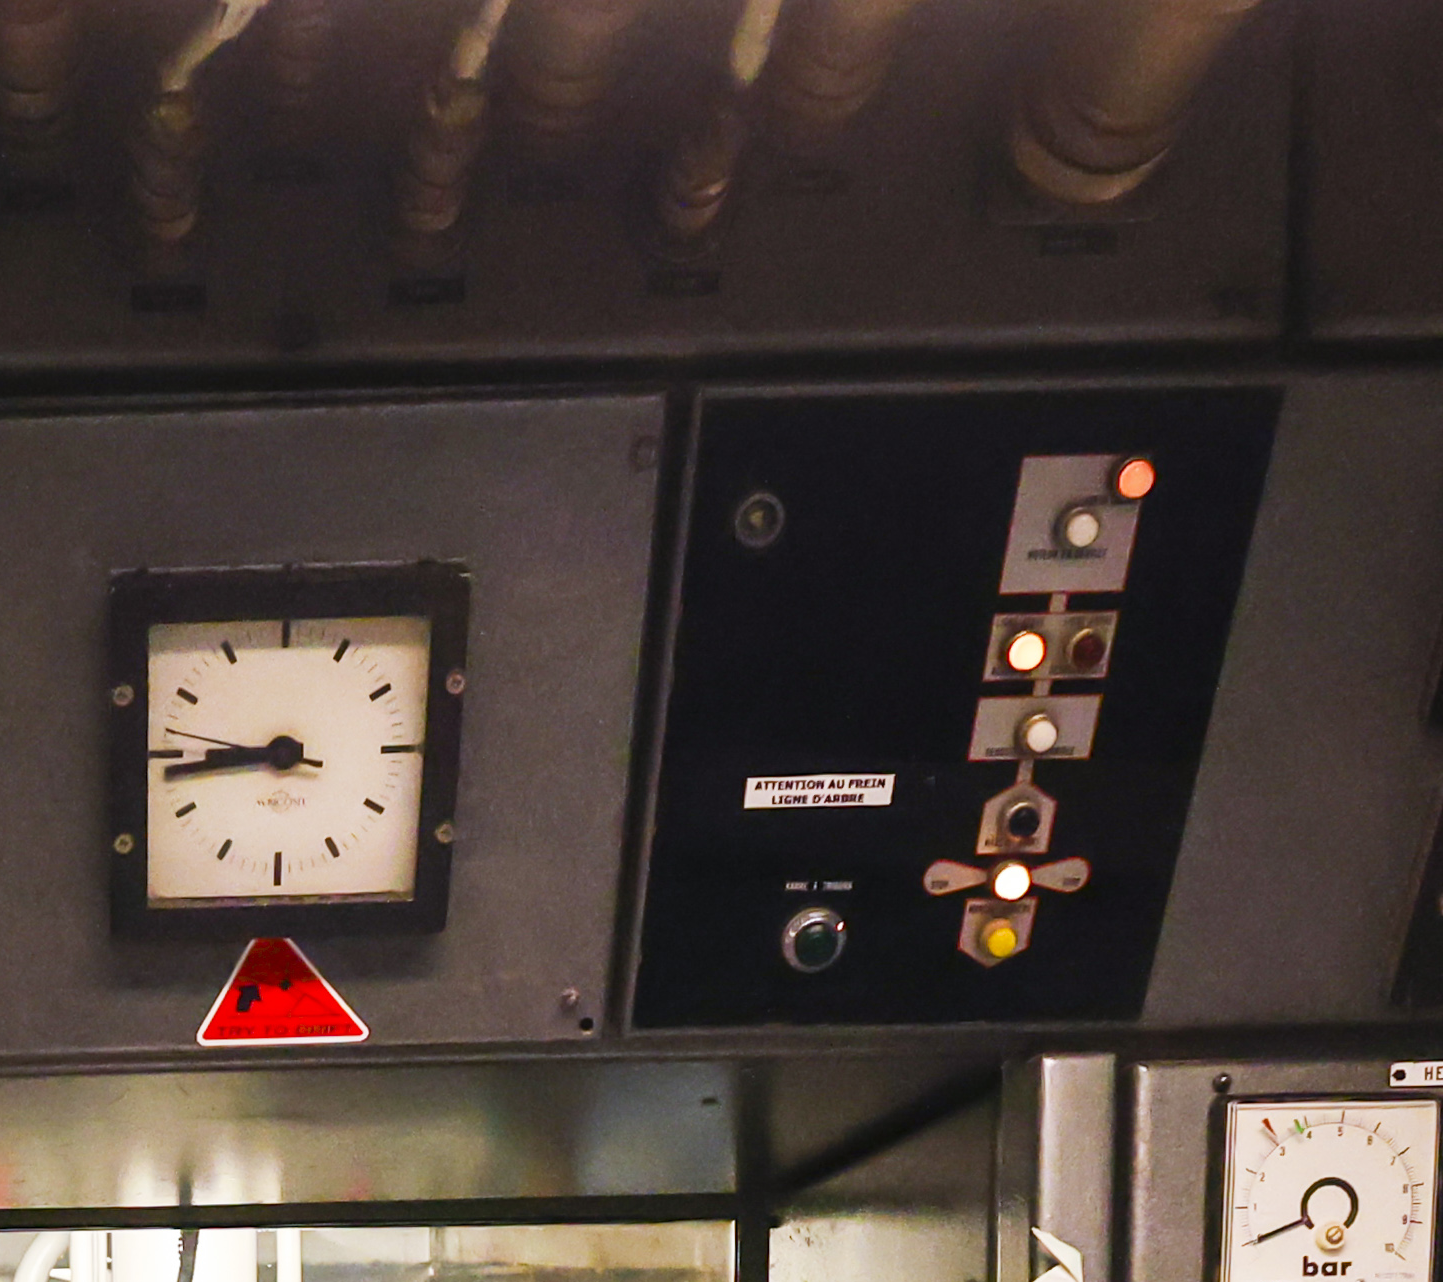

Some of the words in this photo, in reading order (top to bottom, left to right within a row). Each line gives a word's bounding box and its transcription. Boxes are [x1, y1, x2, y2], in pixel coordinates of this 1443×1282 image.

[754, 778, 824, 792] ATTENTION
[828, 777, 845, 789] AU
[848, 776, 885, 789] FREIN
[771, 794, 809, 805] LIGNE
[1302, 1256, 1353, 1277] bar
